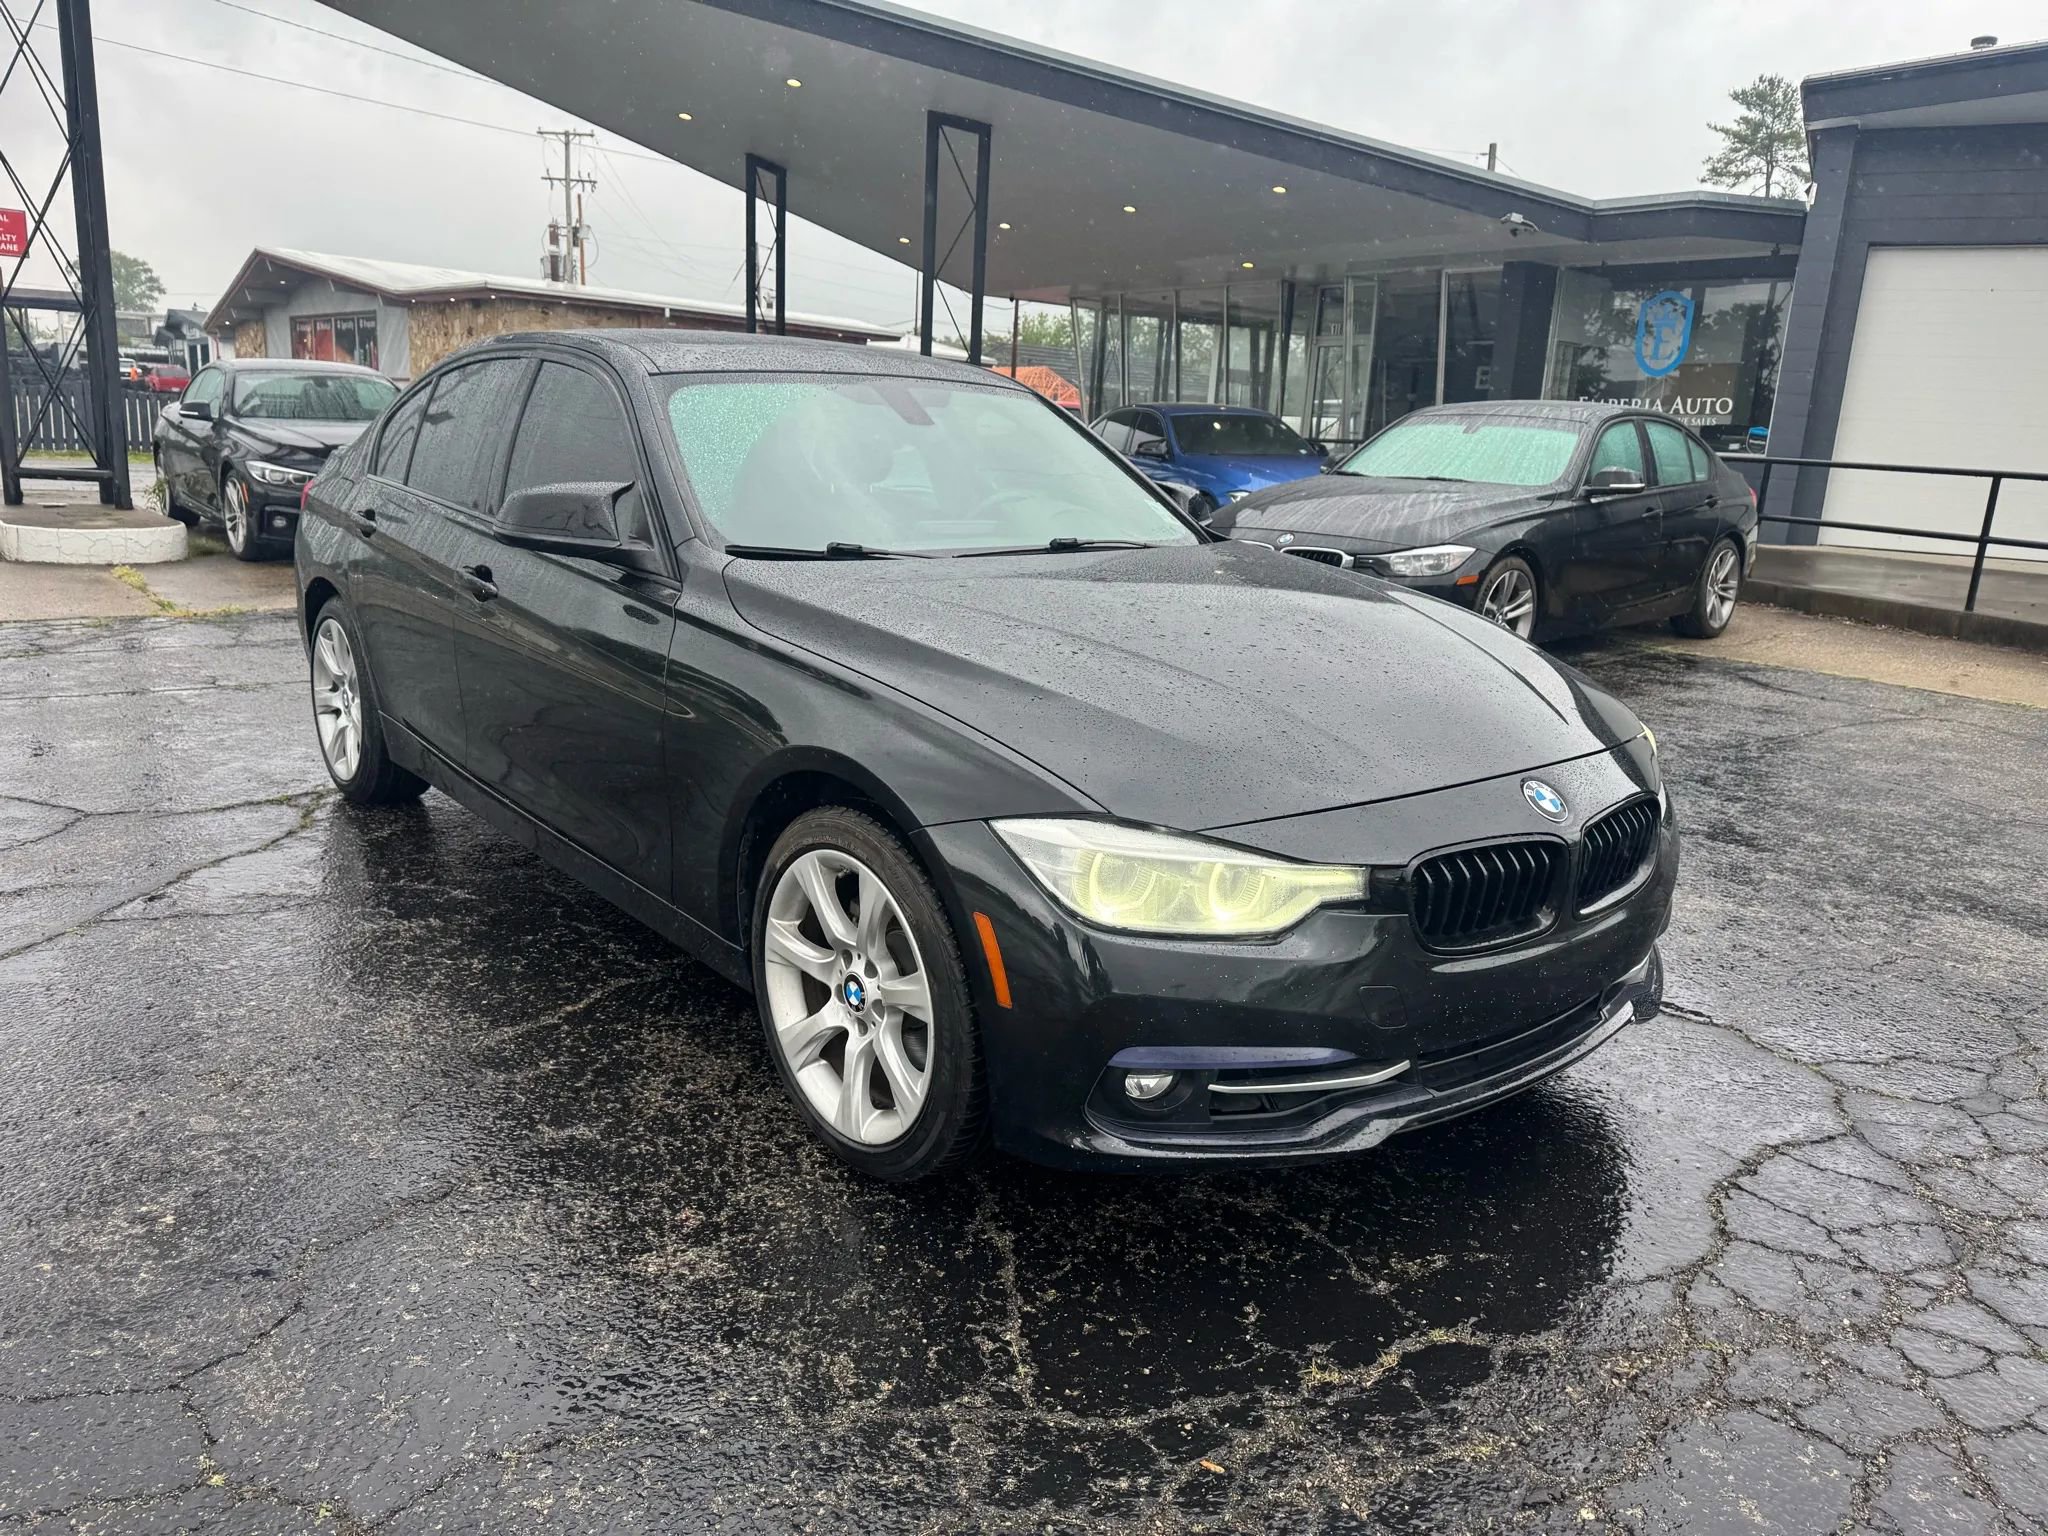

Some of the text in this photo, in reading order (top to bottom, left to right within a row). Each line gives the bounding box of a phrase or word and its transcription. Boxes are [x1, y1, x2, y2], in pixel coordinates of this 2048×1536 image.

[0, 233, 17, 242] LTY
[1579, 395, 1734, 415] PERIA AUTO
[1690, 417, 1718, 427] SALES
